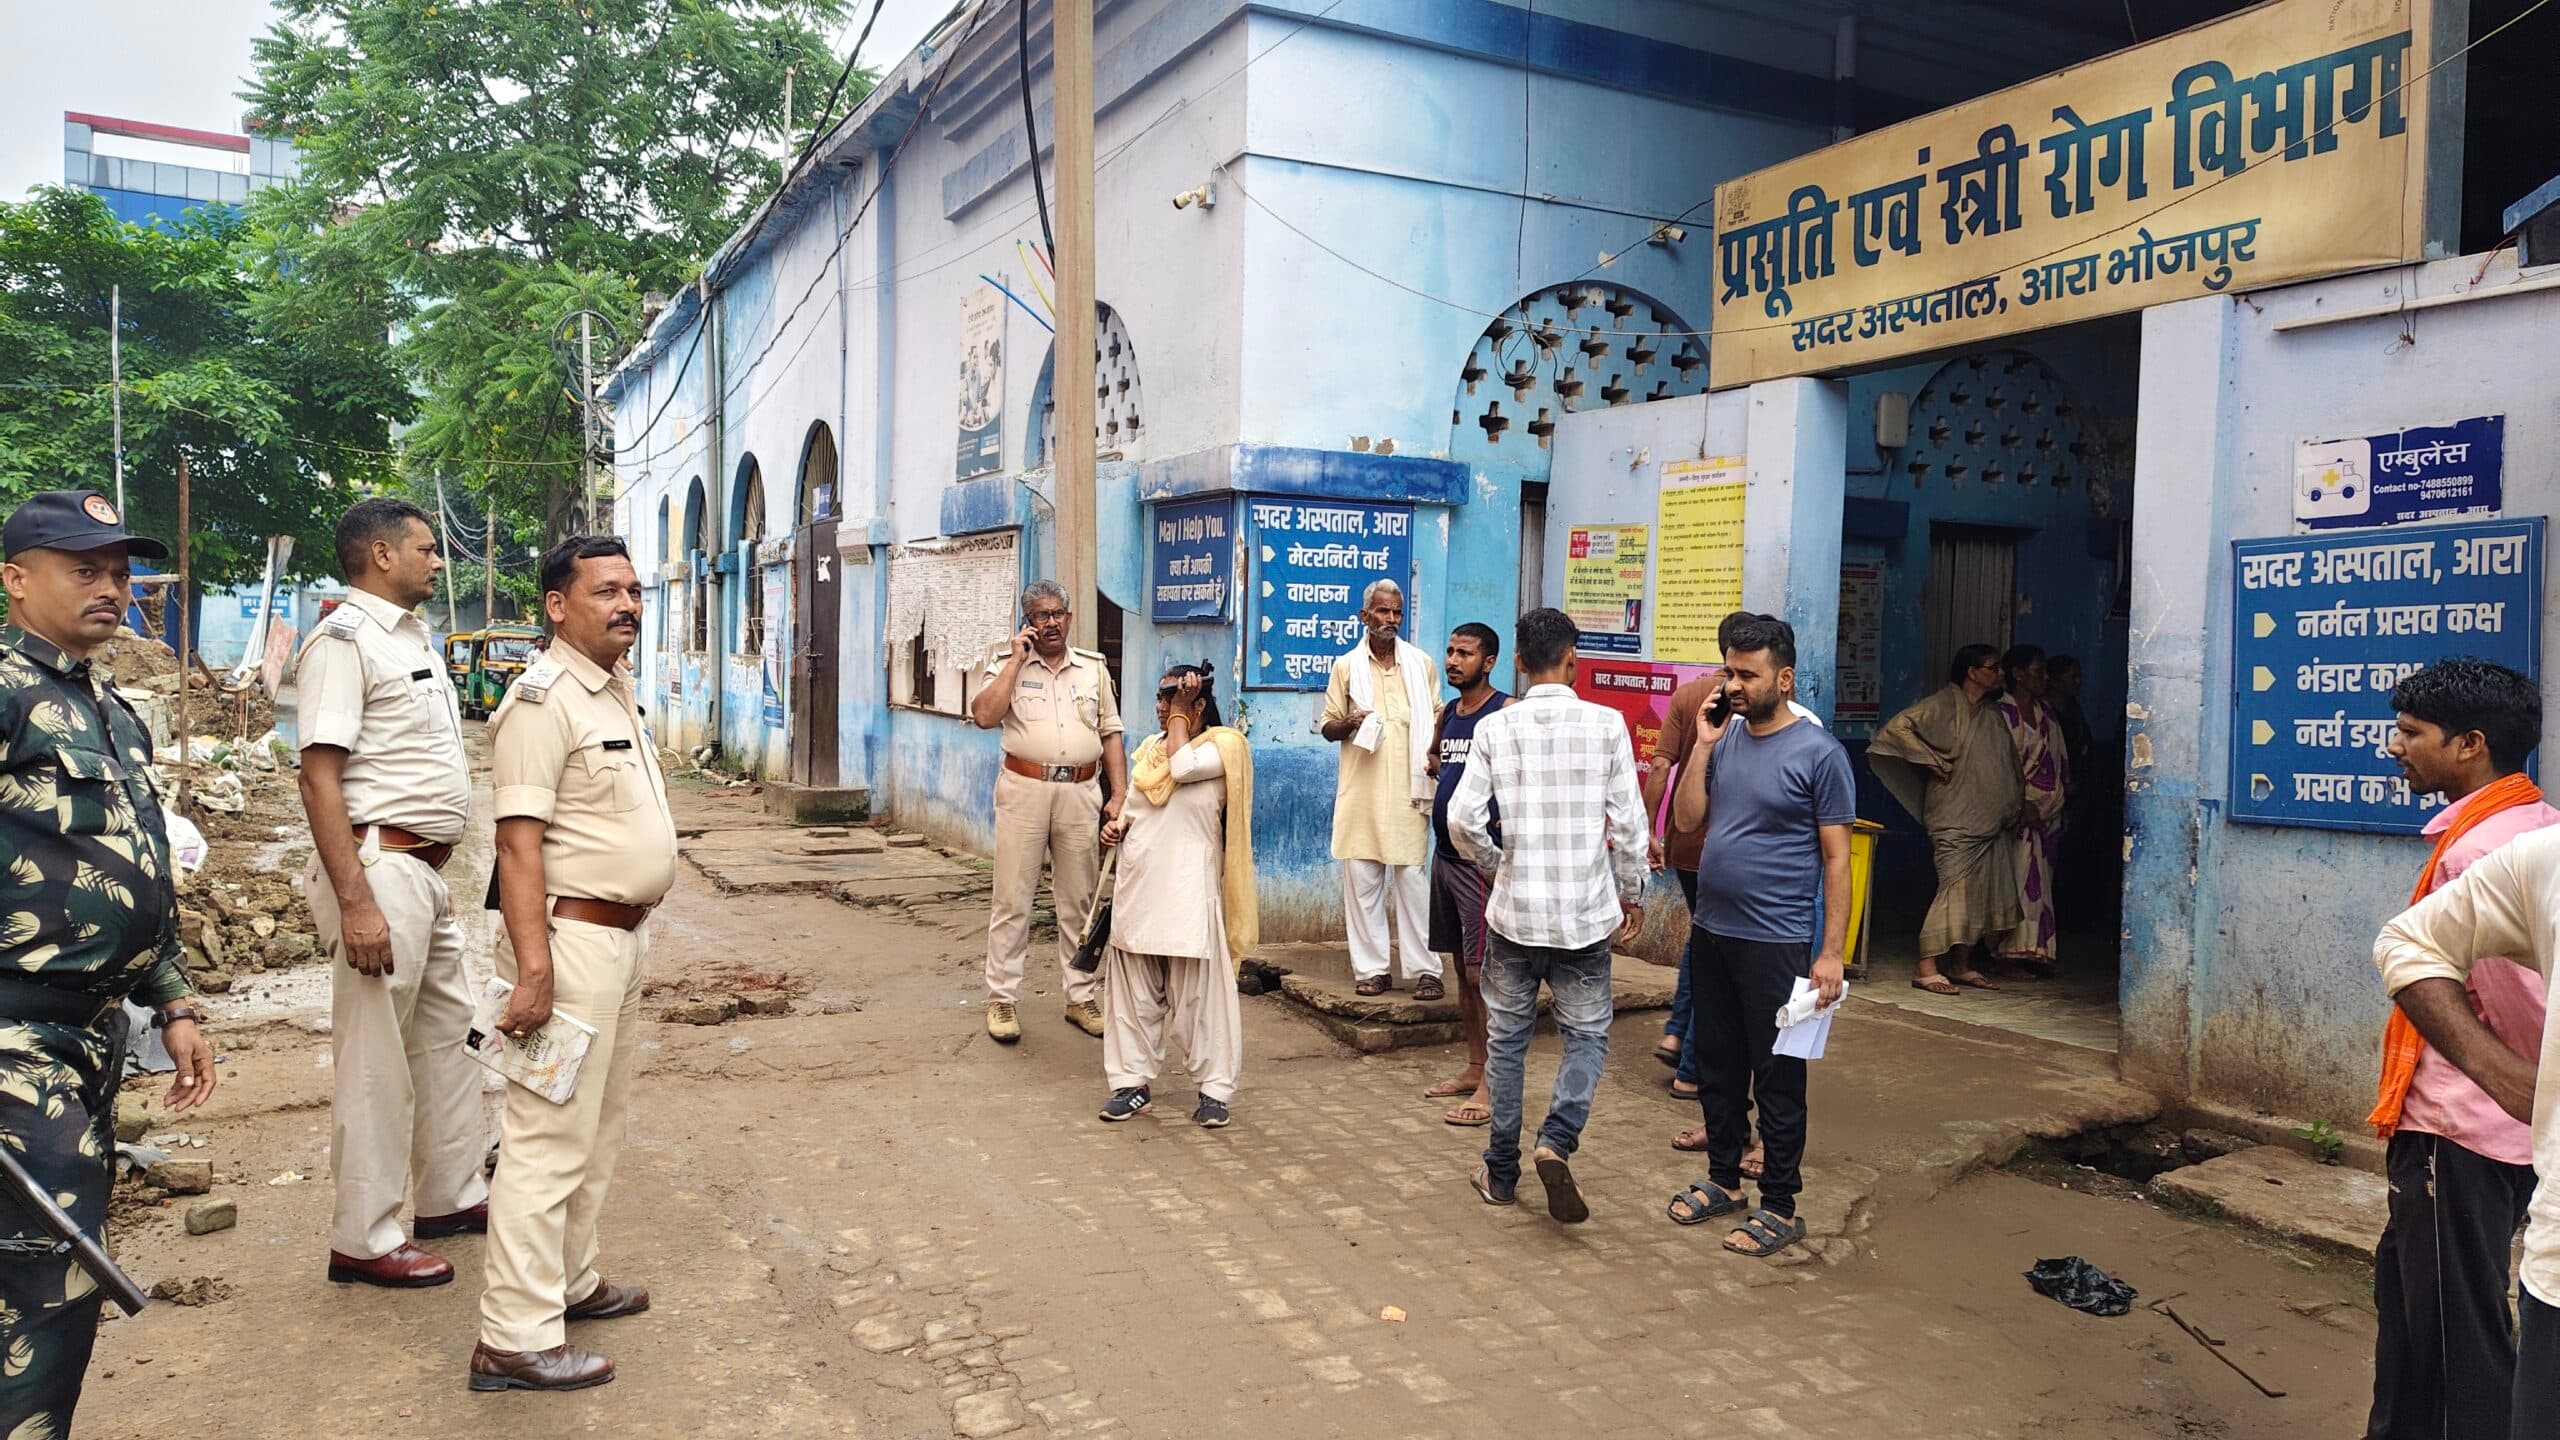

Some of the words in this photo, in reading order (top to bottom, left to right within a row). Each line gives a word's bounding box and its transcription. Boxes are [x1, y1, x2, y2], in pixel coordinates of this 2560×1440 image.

[1719, 185, 1839, 318] प्रसूति
[1848, 147, 1930, 267] एवं
[1937, 124, 2029, 244] स्त्री
[2040, 105, 2152, 218] रोग
[2166, 30, 2412, 189] विभाग
[1792, 310, 1855, 351] सदर
[1859, 276, 2007, 338] अस्पताल,
[2019, 254, 2100, 305] आरा
[2107, 218, 2261, 290] भोजपुर
[2377, 440, 2471, 476] एम्बुलेंस
[2373, 481, 2407, 494] Contact
[1158, 520, 1176, 546] May
[1178, 518, 1182, 541] I
[1183, 515, 1203, 544] Help
[1205, 515, 1226, 538] You.
[1252, 504, 1293, 529] सदर
[1296, 507, 1369, 538] अस्पताल,
[1373, 512, 1409, 537] आरा
[1287, 542, 1360, 568] मेटरनिटी
[1361, 546, 1389, 570] वार्ड
[2241, 552, 2304, 589] सदर
[2310, 541, 2442, 585] अस्पताल,
[2452, 535, 2528, 575] आरा
[1286, 583, 1350, 603] वाशरूम
[1285, 613, 1319, 638] नर्स
[2295, 600, 2370, 638] नर्मल
[2374, 605, 2441, 635] प्रसव
[2445, 602, 2505, 633] कक्ष
[1284, 654, 1334, 679] सुरक्षा
[2297, 656, 2364, 692] भंडार
[2293, 710, 2345, 748] नर्स
[1440, 738, 1472, 753] OMM
[2292, 773, 2355, 803] प्रसव
